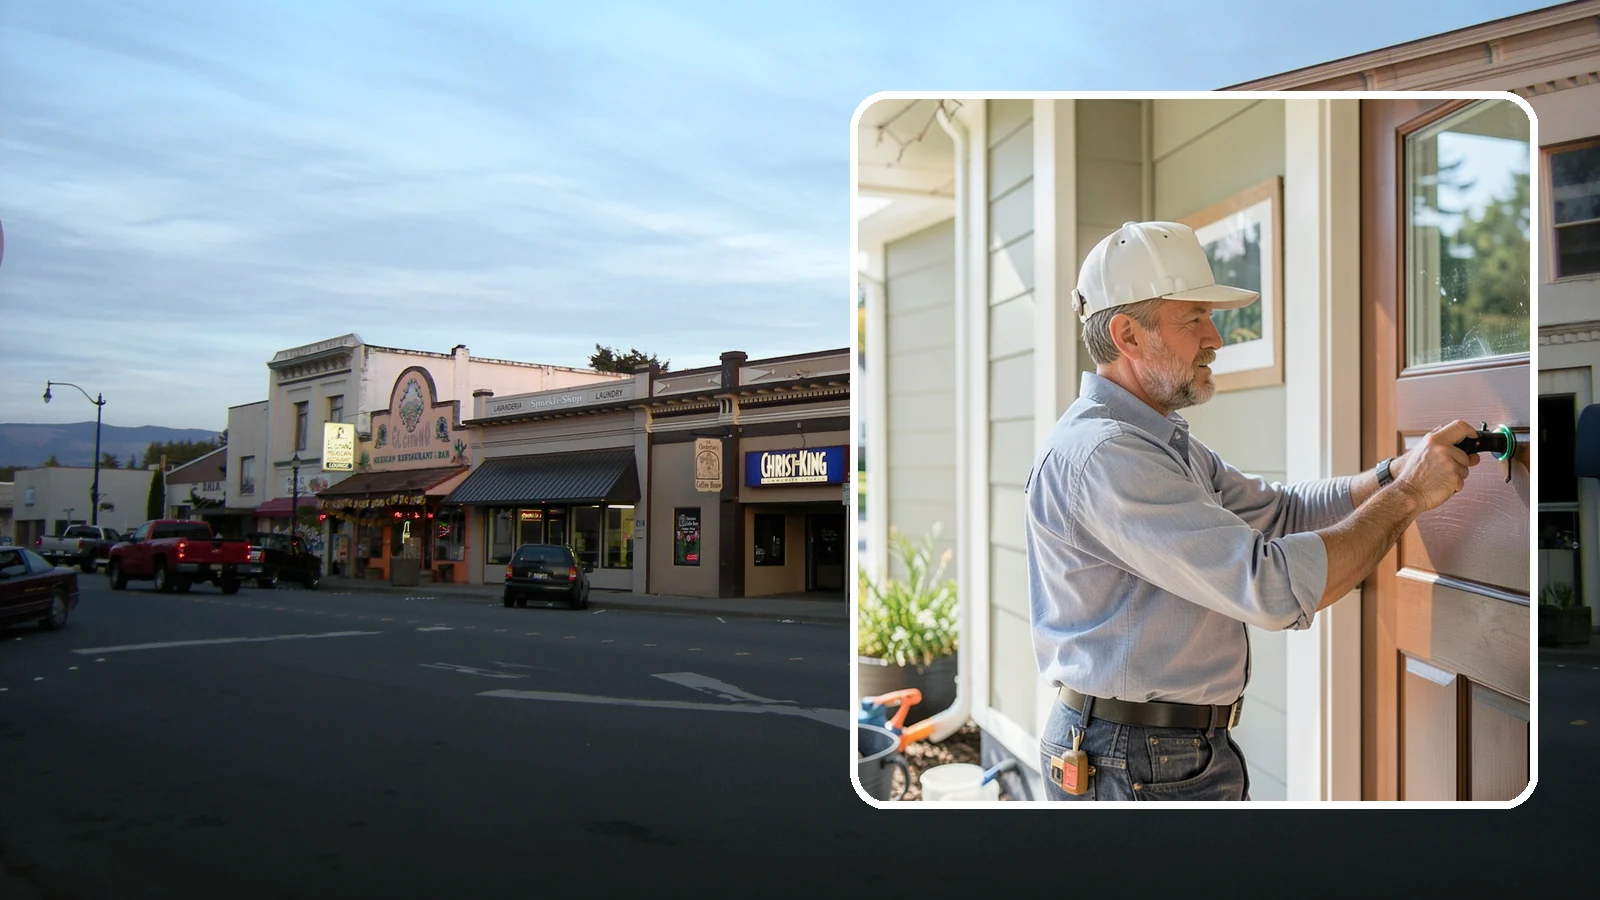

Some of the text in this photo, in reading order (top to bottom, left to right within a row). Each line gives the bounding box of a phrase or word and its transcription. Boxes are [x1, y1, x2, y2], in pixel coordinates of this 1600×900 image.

[531, 394, 583, 409] Sparkle Shop
[595, 389, 624, 400] LAUNDRY
[493, 402, 523, 413] LAVANDERIA
[373, 455, 396, 464] MEXICAN
[397, 452, 433, 463] RESTAURANT
[437, 450, 450, 459] BAR
[761, 450, 828, 478] CHRIST KING
